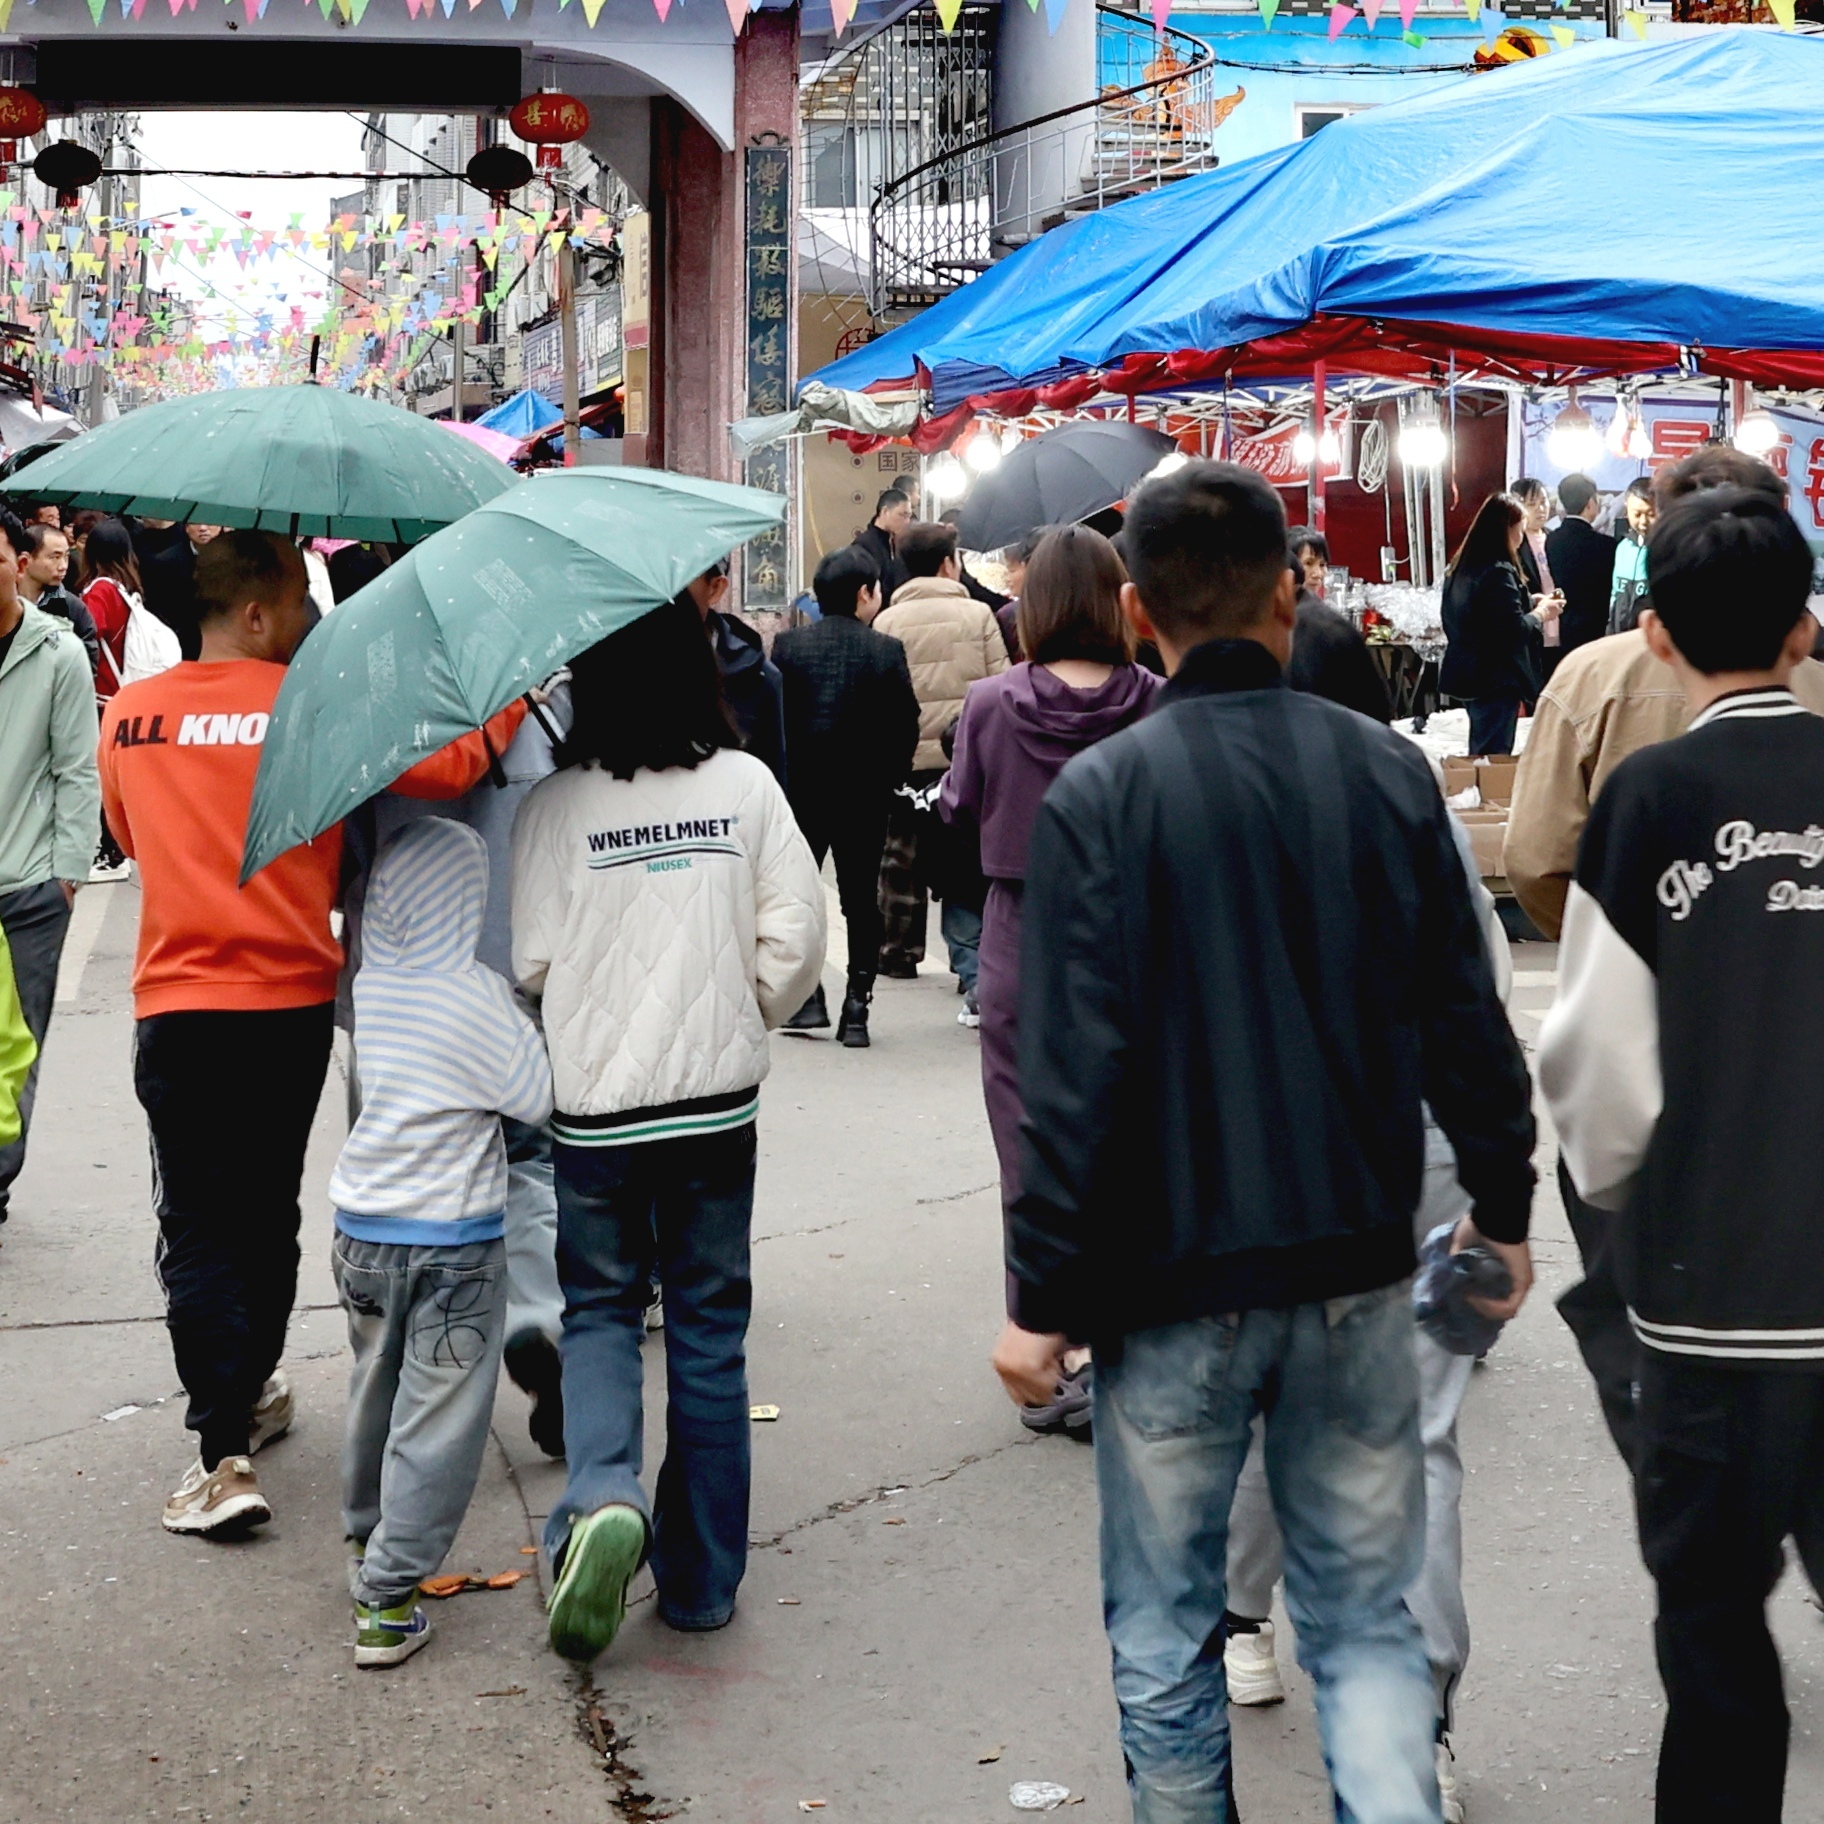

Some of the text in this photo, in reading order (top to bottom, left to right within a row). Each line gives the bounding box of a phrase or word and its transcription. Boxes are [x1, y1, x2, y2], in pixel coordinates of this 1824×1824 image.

[113, 714, 168, 750] ALL
[646, 858, 693, 874] NIUSEX
[1656, 859, 1715, 921] The
